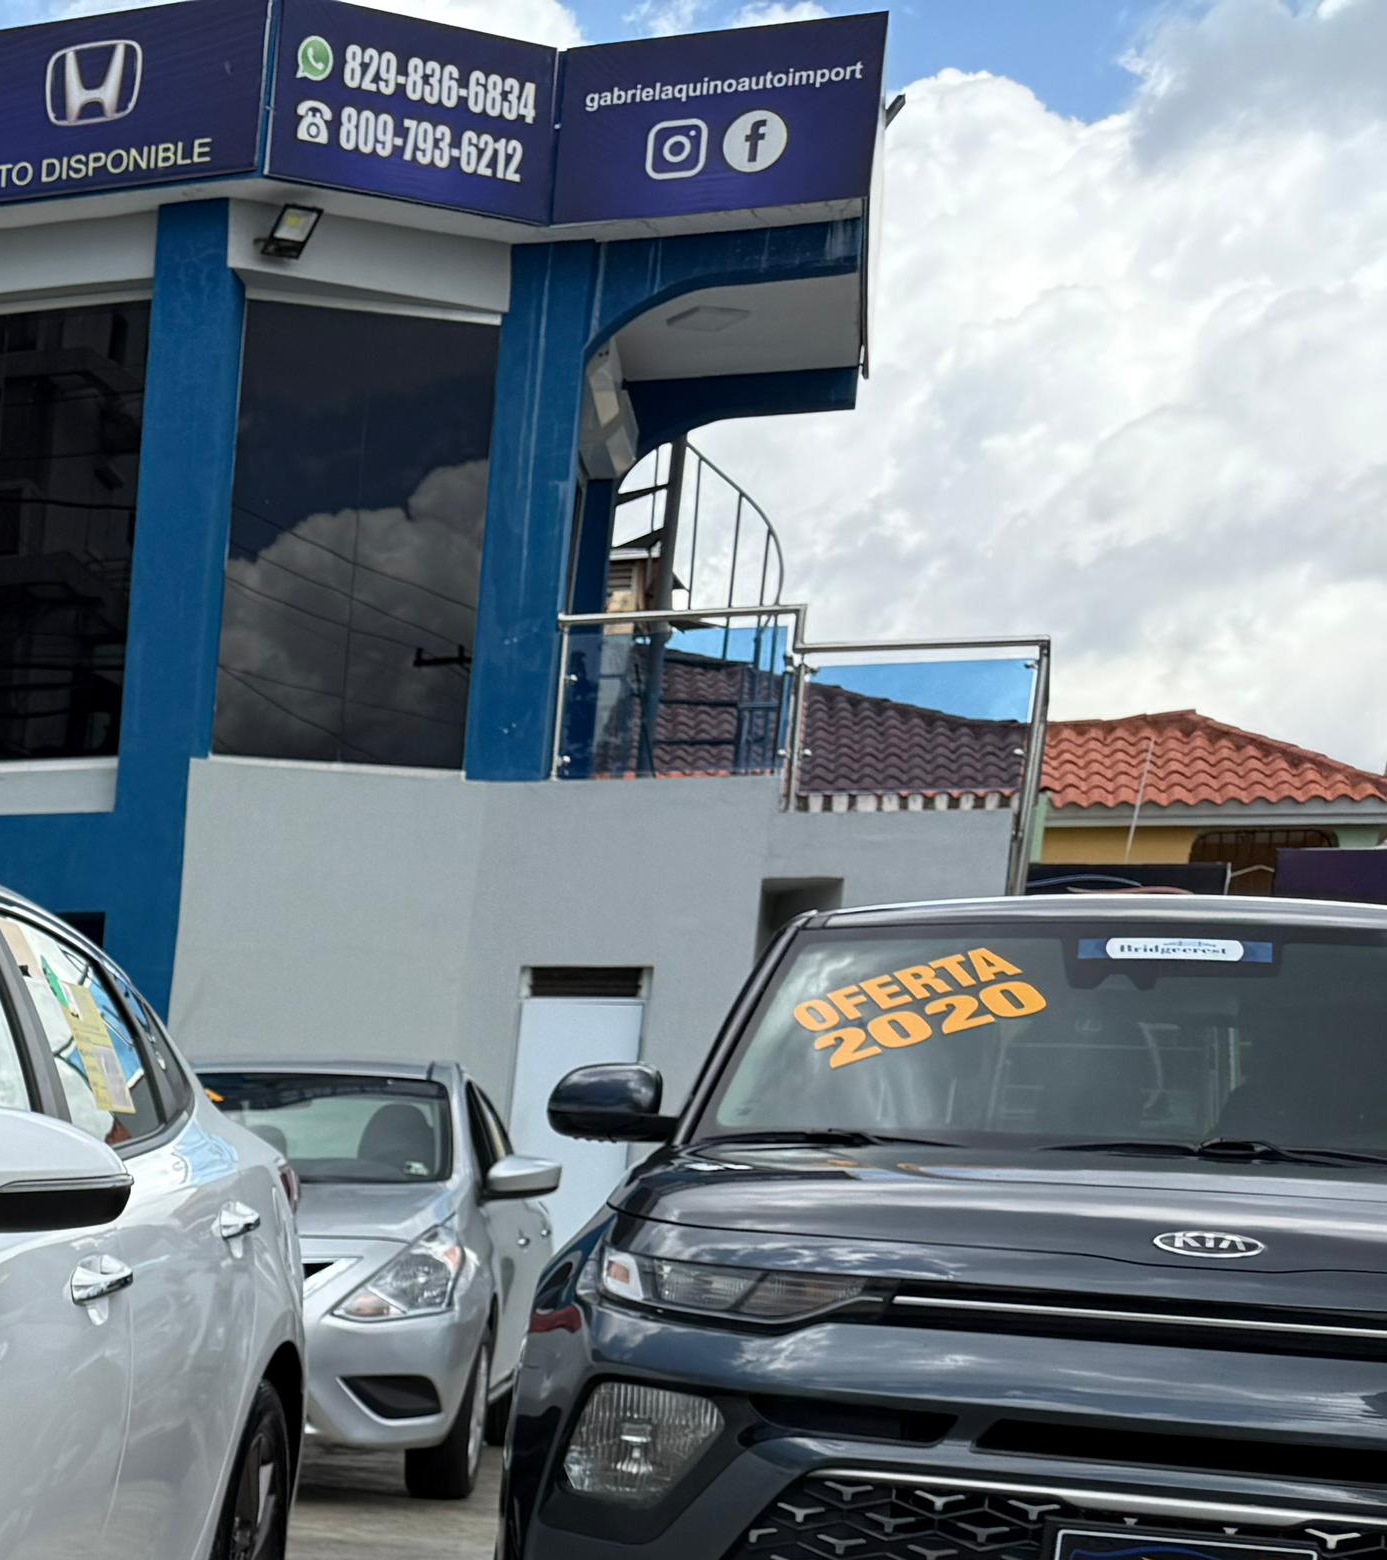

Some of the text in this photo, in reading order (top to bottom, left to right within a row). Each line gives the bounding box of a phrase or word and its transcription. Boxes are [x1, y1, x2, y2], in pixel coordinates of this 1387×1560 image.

[343, 44, 536, 125] 829-836-6834
[585, 61, 864, 112] gabrielaquinoautoimport
[41, 138, 213, 183] DISPONIBLE
[339, 106, 523, 183] 809-793-6212
[792, 947, 1024, 1033] OFERTA
[814, 980, 1047, 1070] 2020
[1173, 1231, 1247, 1252] KIA
